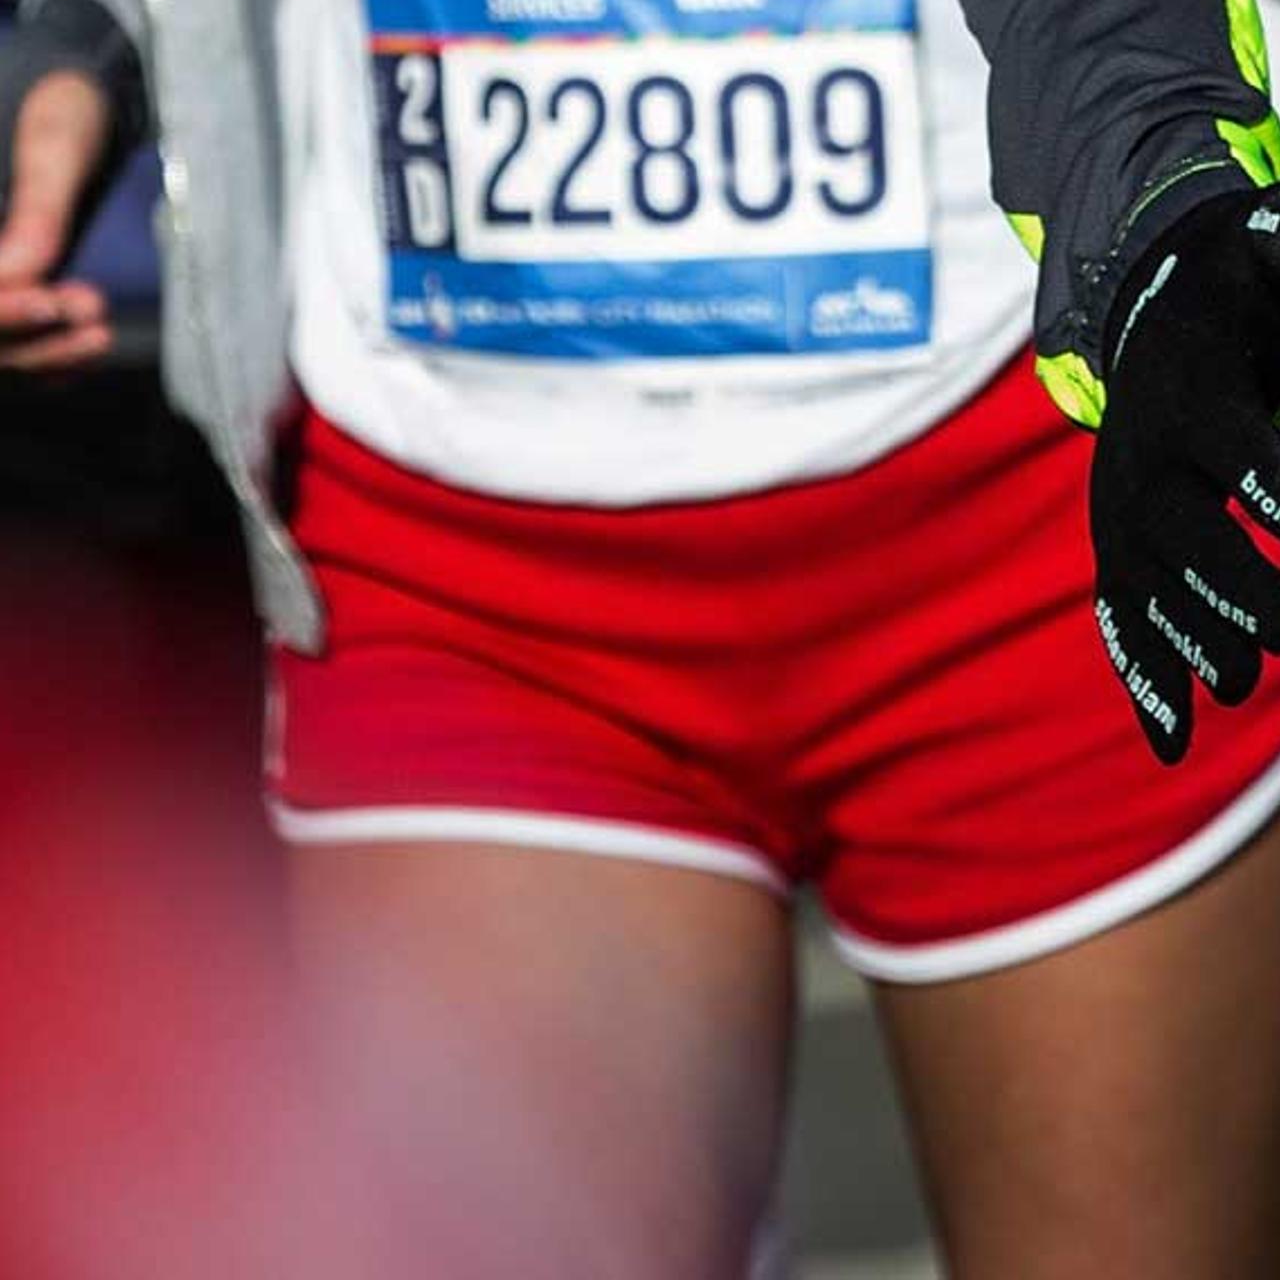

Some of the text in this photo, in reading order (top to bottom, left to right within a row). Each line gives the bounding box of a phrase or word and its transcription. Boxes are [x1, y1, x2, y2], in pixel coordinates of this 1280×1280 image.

[396, 55, 438, 145] 2
[480, 67, 888, 227] 22809
[403, 157, 450, 249] D
[1147, 596, 1219, 689] brooklyn
[1184, 566, 1259, 635] queens
